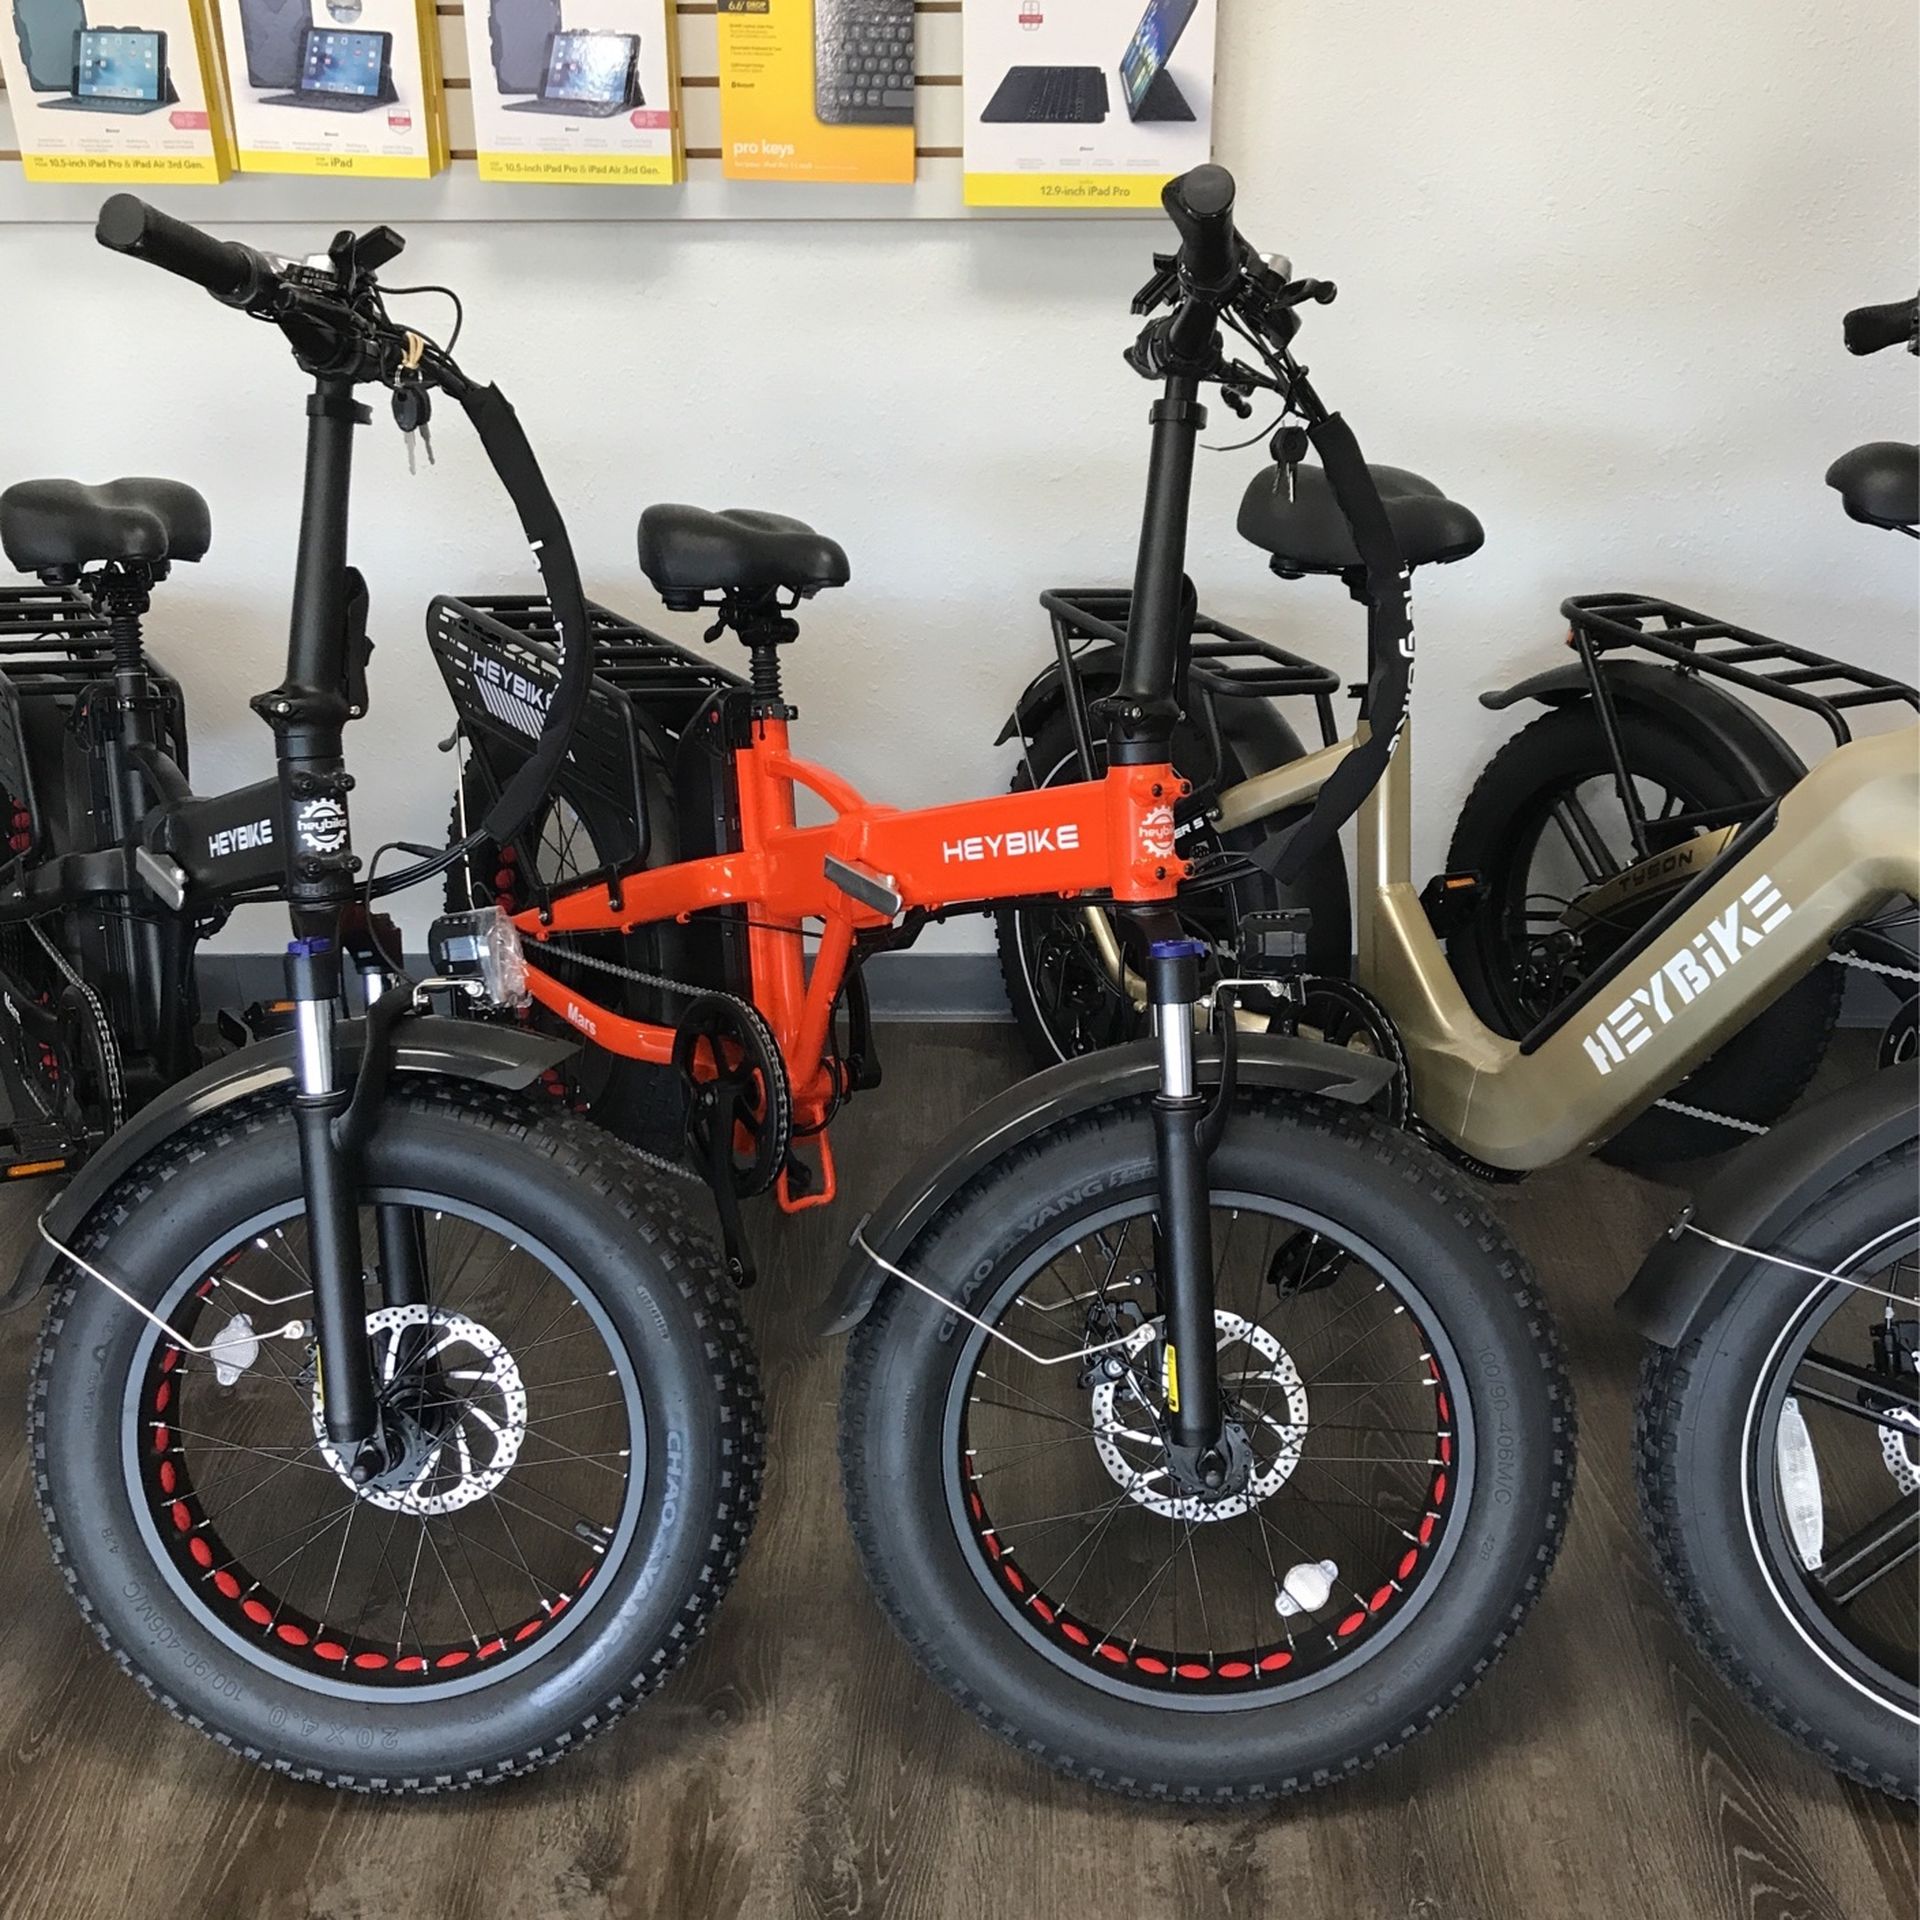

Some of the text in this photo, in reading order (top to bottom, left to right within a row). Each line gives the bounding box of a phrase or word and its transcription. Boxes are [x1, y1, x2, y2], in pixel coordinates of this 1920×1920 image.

[733, 138, 795, 159] pro keys
[88, 159, 106, 169] iPad
[108, 160, 122, 169] Pro
[133, 160, 151, 169] iPad
[153, 160, 165, 169] Air
[167, 160, 182, 169] 3rd
[330, 157, 353, 168] iPad
[543, 164, 562, 173] iPad
[564, 164, 578, 173] Pro
[588, 165, 607, 174] iPad
[609, 165, 621, 174] Air
[623, 165, 638, 174] 3rd
[1040, 185, 1131, 197] 12.9-inch iPad Pro
[472, 651, 551, 711] HEYBIK
[208, 818, 274, 858] HEYBIKE
[296, 817, 348, 833] heybike
[942, 824, 1080, 864] HEYBIKE
[567, 1002, 597, 1036] Mars
[1018, 1176, 1104, 1234] YANG
[661, 1430, 682, 1528] CHAO
